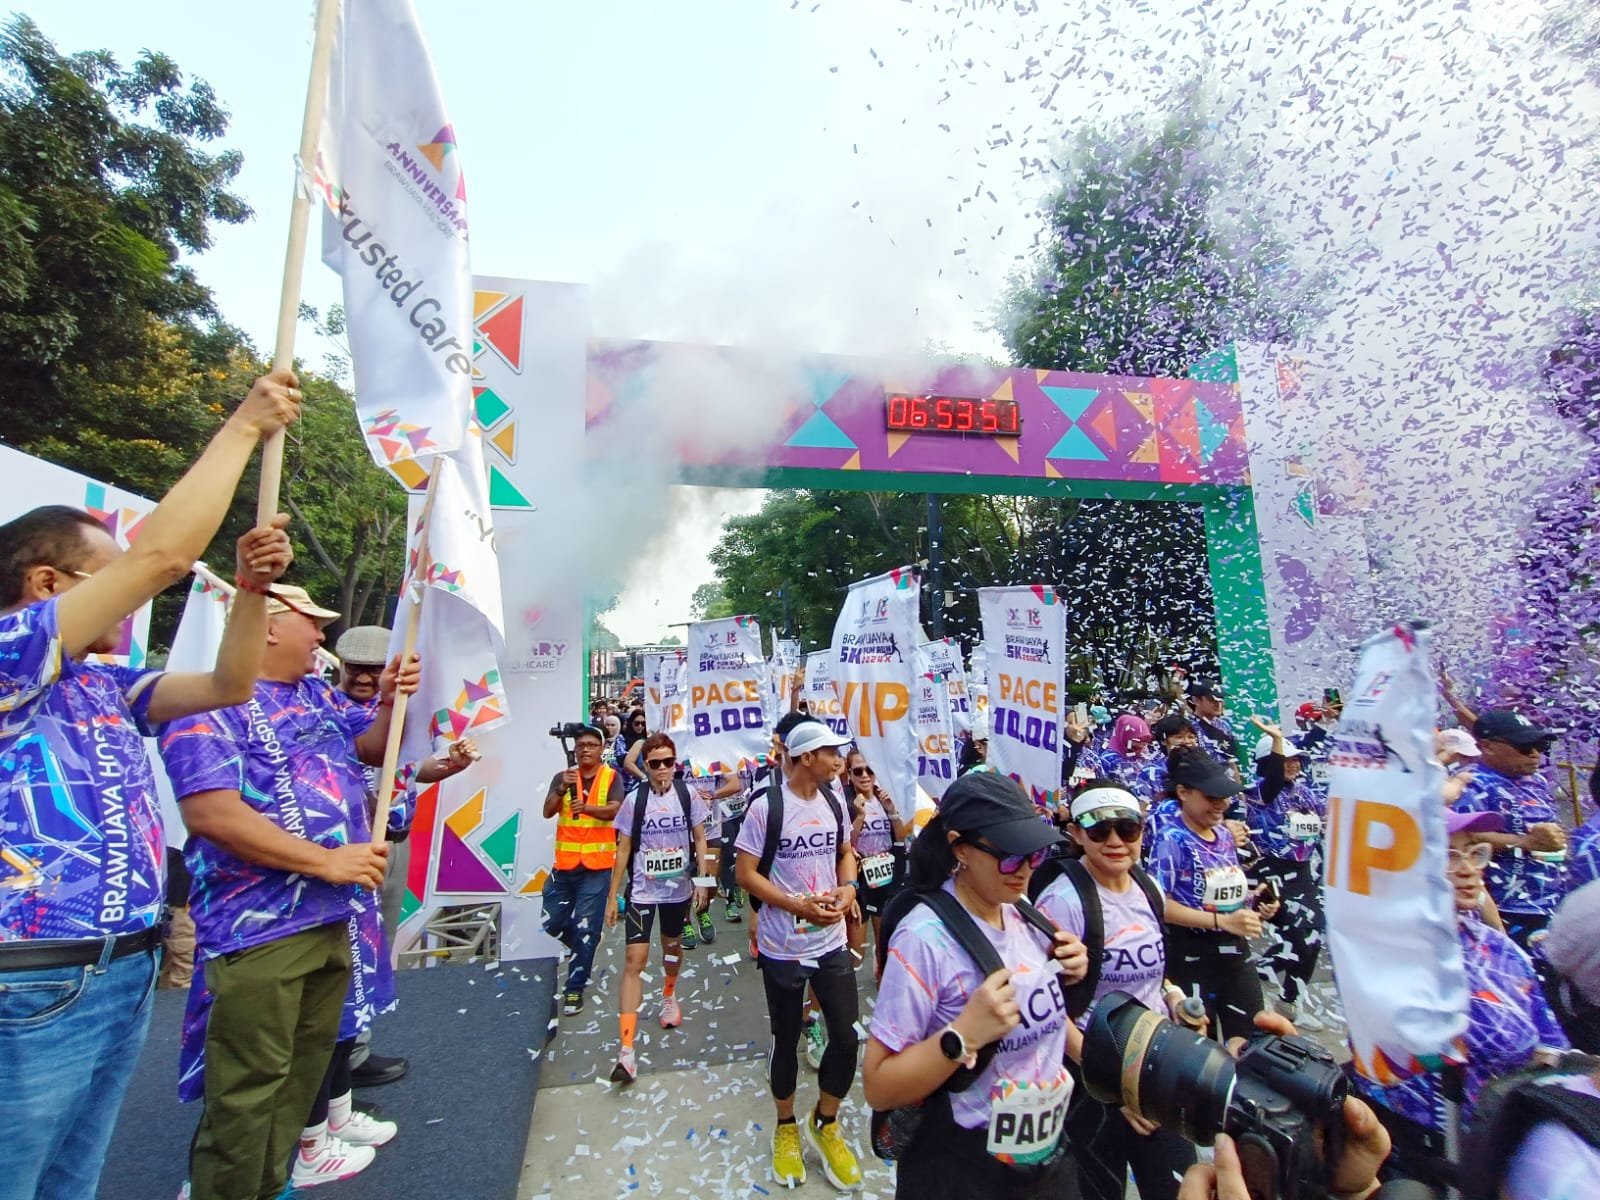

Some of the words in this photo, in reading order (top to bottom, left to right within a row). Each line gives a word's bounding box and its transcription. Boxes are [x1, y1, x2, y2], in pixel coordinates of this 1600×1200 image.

[386, 142, 468, 241] ANNIVERSAR
[409, 298, 471, 374] Care
[699, 661, 715, 672] 5K
[840, 646, 862, 664] 5K
[1006, 644, 1022, 660] 5K
[690, 680, 760, 708] PACE
[808, 698, 841, 715] PAC
[998, 673, 1057, 714] PACE
[693, 706, 764, 737] 8.00
[993, 707, 1058, 754] 10.00
[100, 783, 129, 923] BRAWIJAYA
[778, 831, 835, 851] PACE
[1327, 796, 1424, 897] IP
[646, 857, 682, 872] PACER
[1214, 884, 1243, 901] 1678
[351, 940, 365, 1003] BRAWIJAYA
